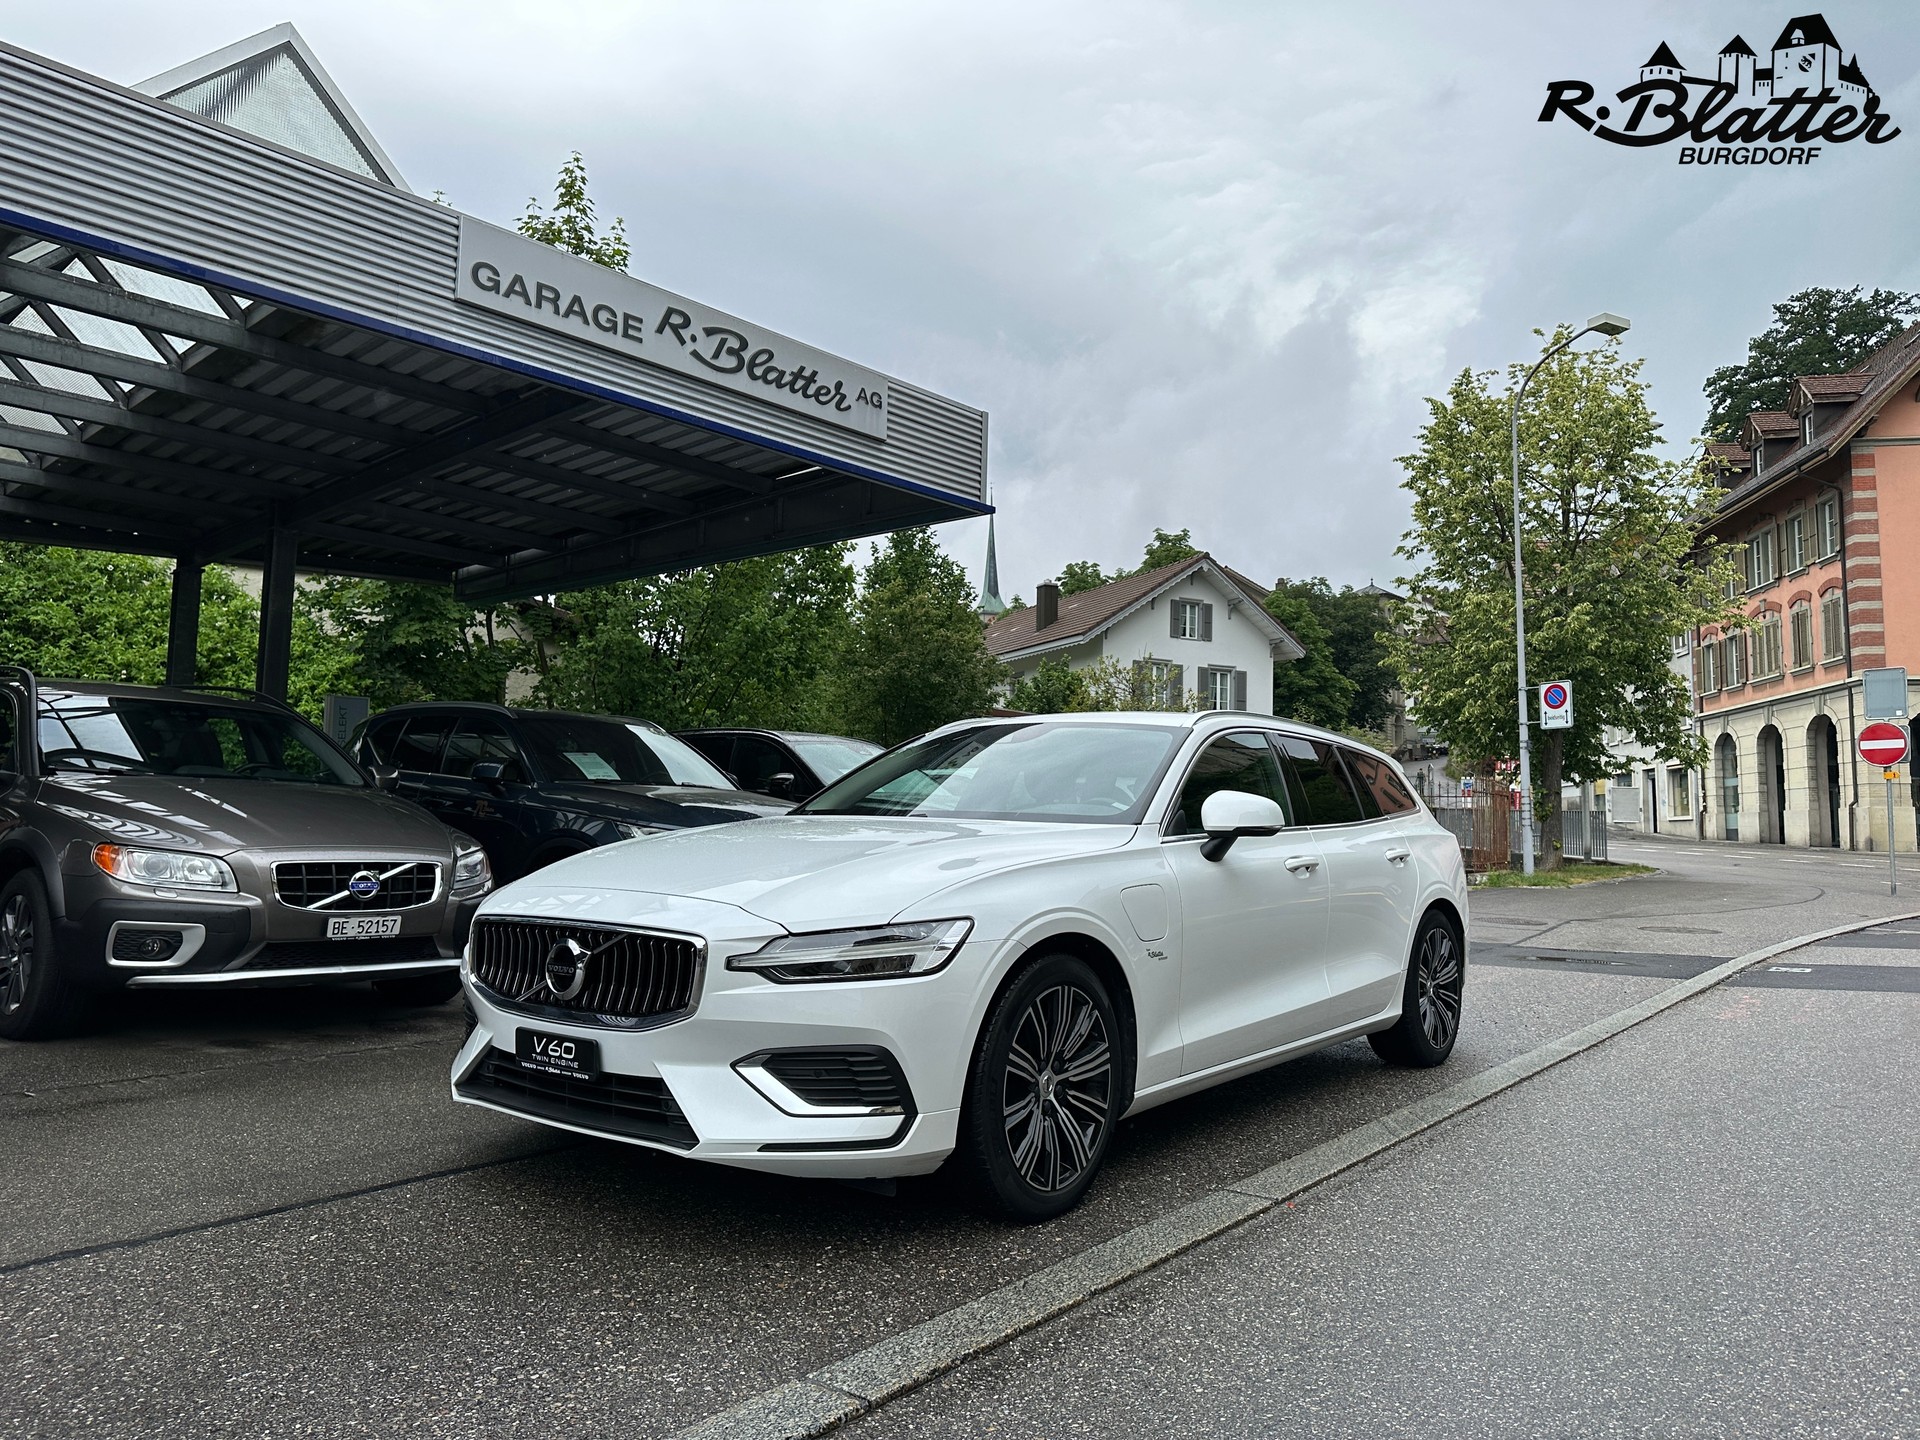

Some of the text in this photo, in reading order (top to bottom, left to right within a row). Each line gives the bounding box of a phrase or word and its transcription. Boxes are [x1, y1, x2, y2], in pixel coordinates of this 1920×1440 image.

[471, 261, 644, 344] GARAGE
[855, 386, 883, 410] AG
[548, 964, 575, 974] VOLVO
[532, 1053, 579, 1069] TWIN ENGINE
